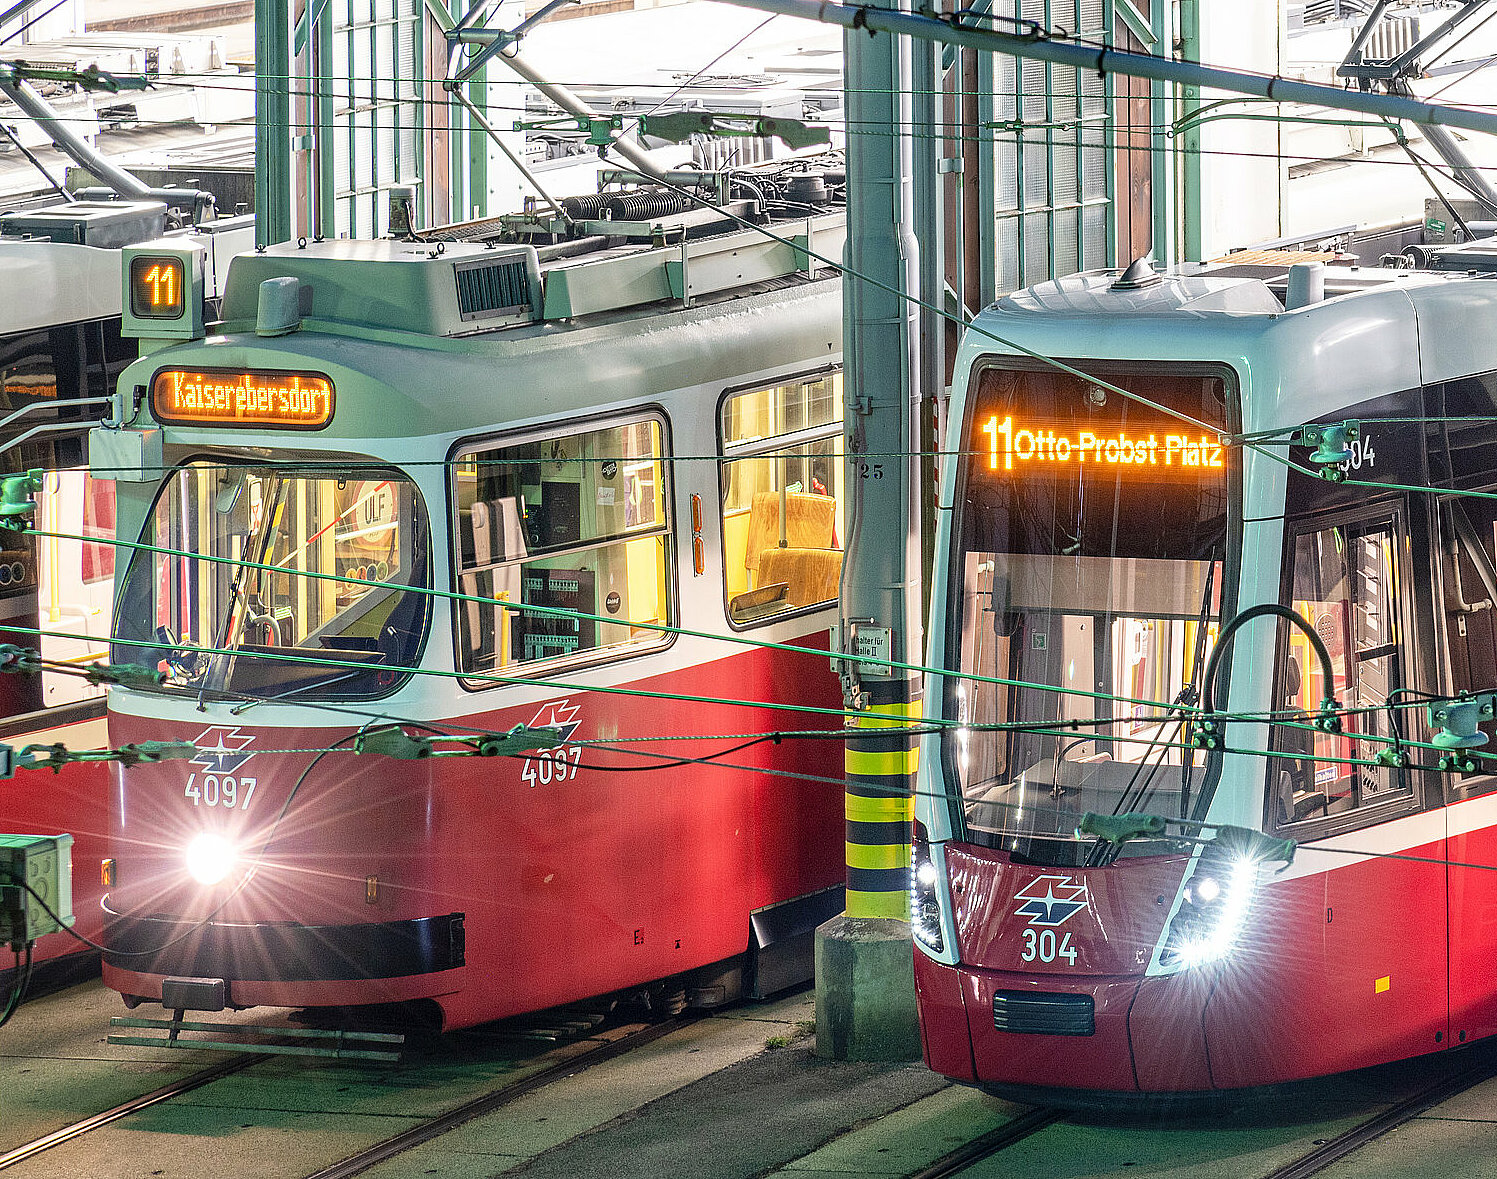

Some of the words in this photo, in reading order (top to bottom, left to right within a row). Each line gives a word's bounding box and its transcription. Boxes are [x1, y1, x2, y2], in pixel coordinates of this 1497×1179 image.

[145, 264, 175, 306] 11
[173, 371, 330, 414] Kaiserebersdorf
[982, 416, 1012, 469] 11
[1014, 430, 1222, 467] Otto-Probst-Platz
[861, 463, 884, 480] 25
[364, 492, 386, 525] ULF
[521, 746, 582, 788] 4097
[184, 772, 257, 811] 4097
[1020, 928, 1078, 967] 304
